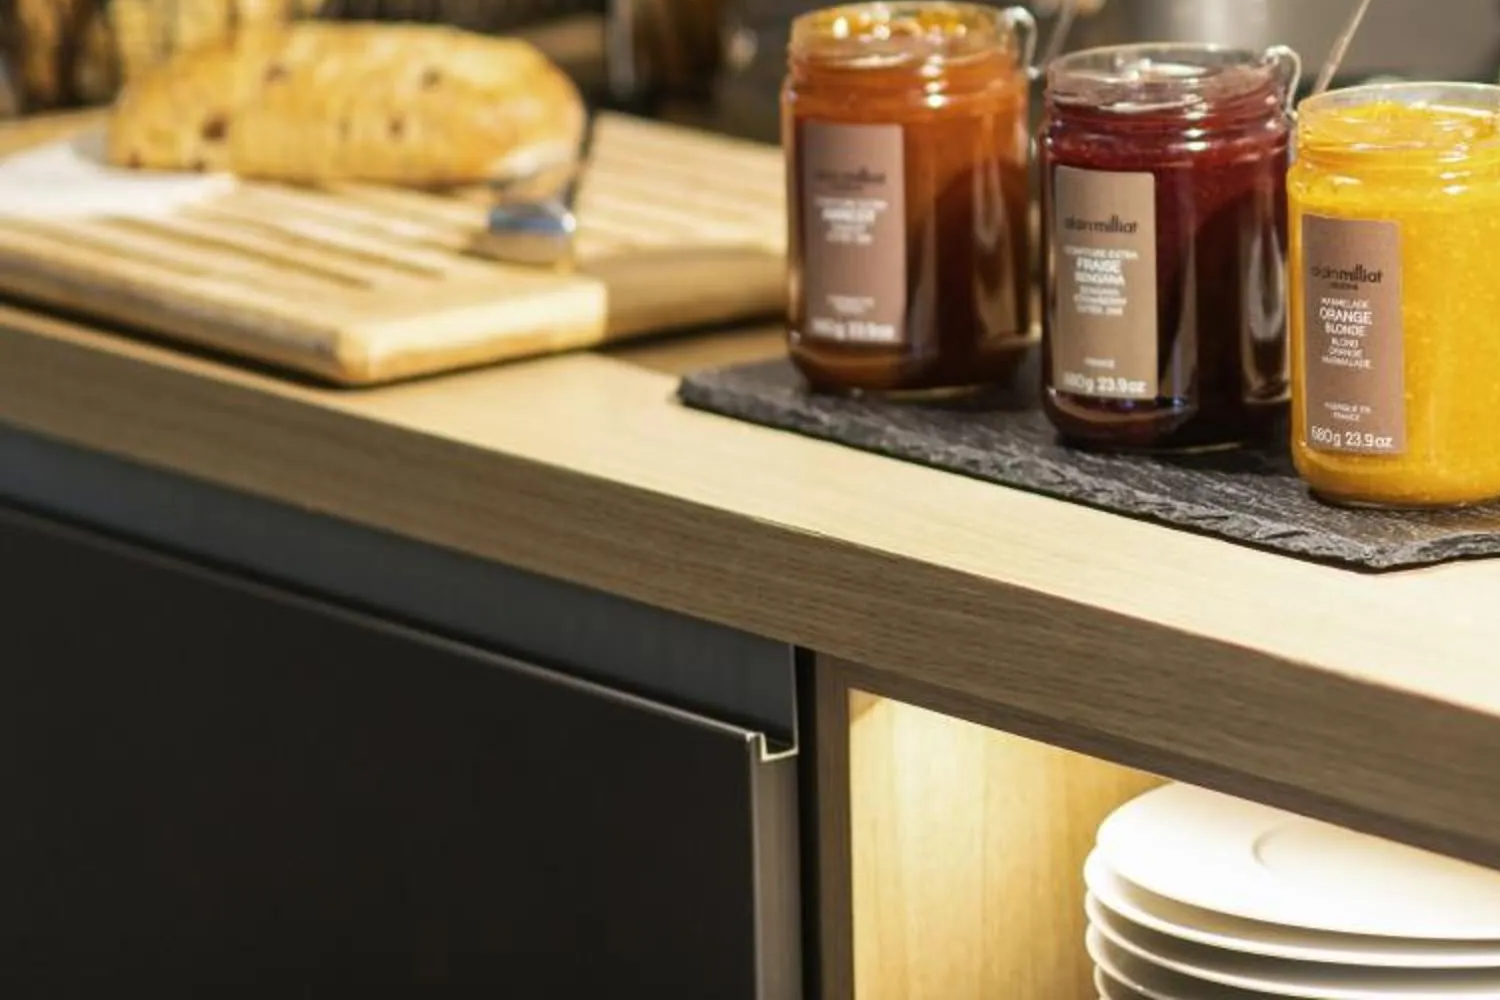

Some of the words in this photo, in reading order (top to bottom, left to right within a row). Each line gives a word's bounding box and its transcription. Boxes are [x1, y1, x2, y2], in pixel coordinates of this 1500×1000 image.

[1320, 306, 1373, 326] ORANGE
[1325, 321, 1367, 337] BLONDE
[1311, 425, 1342, 448] 680g
